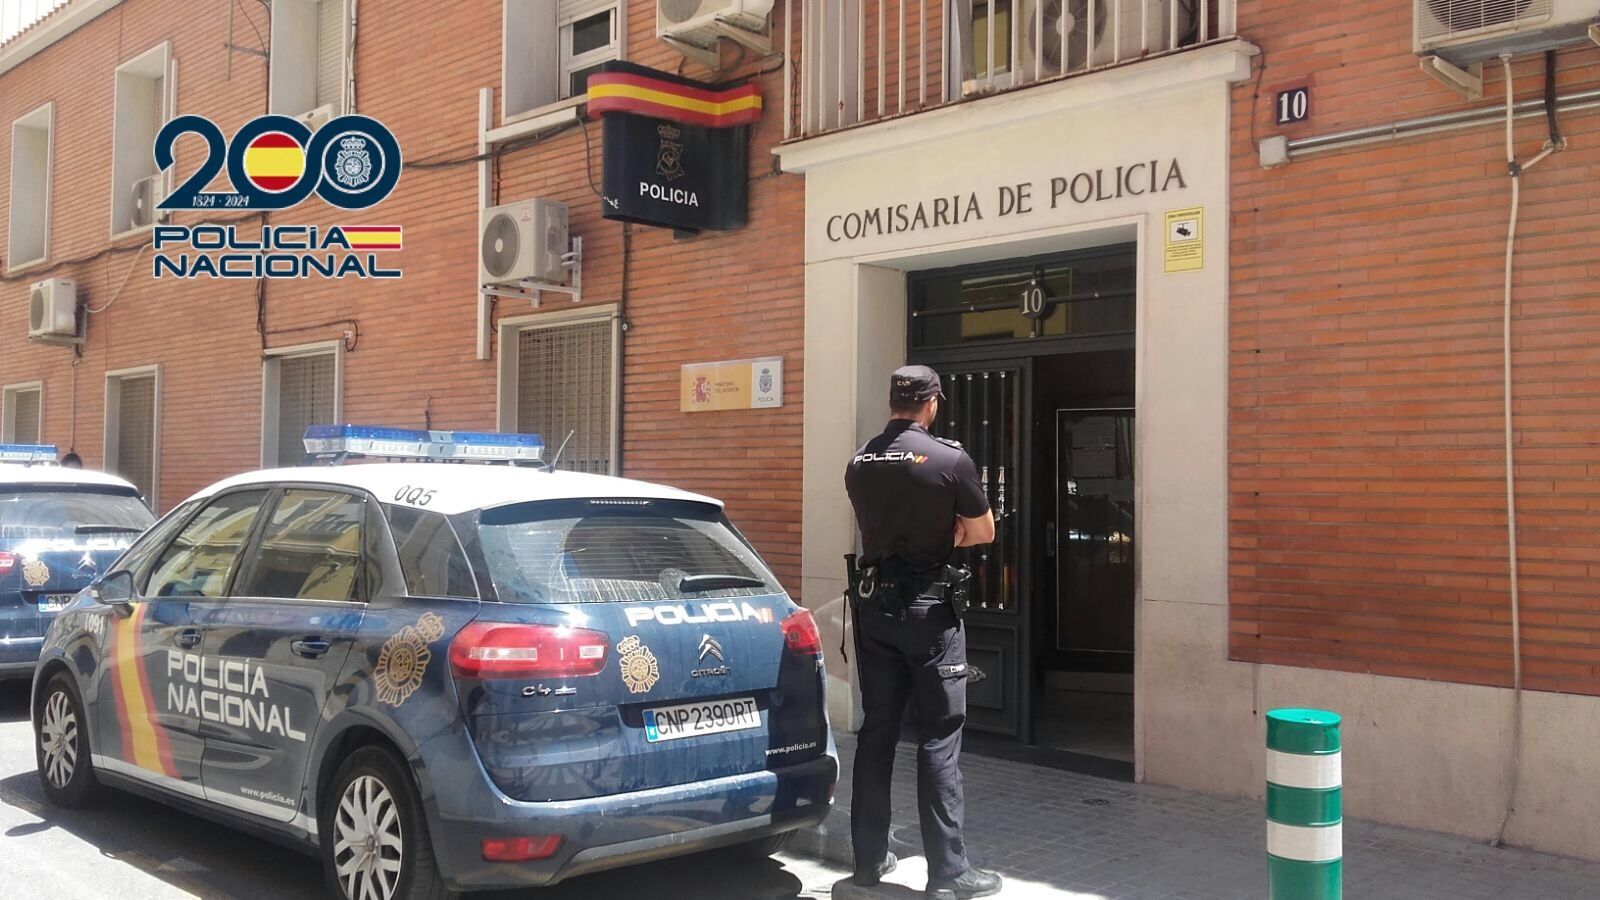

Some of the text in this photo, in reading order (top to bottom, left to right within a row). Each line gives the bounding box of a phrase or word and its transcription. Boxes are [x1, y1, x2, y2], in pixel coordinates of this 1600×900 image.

[1279, 90, 1307, 122] 10
[640, 181, 699, 207] POLICIA
[826, 157, 1187, 242] COMISARIA DE POLICIA
[1021, 288, 1042, 314] 10
[168, 650, 270, 698] POLICÍA
[168, 682, 307, 742] NACIONAL
[765, 741, 817, 756] www.policia.es
[240, 786, 295, 806] www.policia.es
